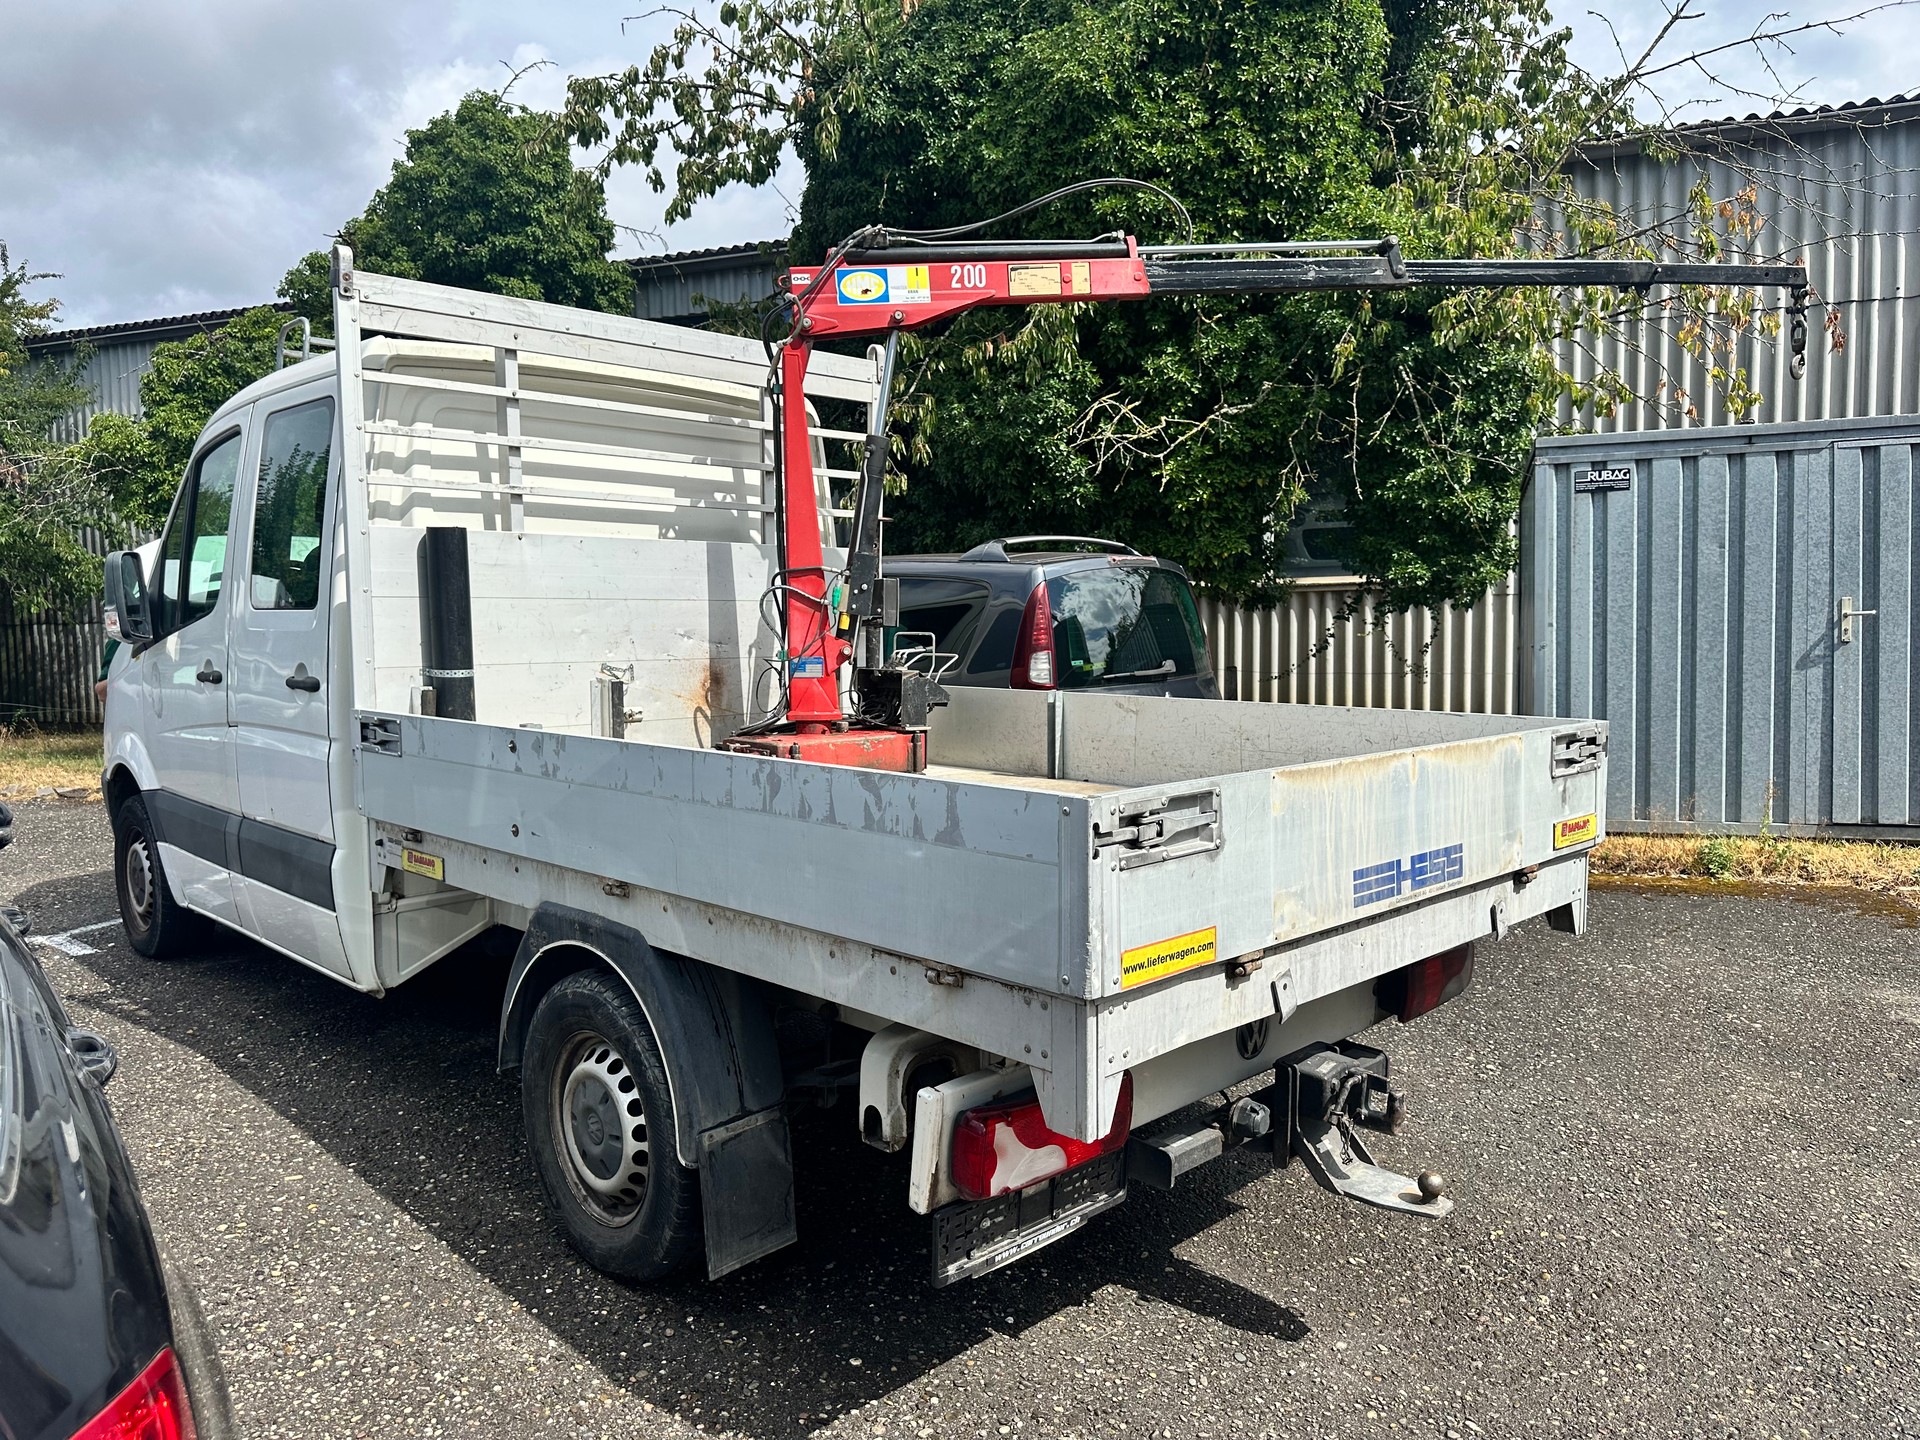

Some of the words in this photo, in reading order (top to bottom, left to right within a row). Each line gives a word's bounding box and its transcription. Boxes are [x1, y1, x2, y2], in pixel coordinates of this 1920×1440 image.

[950, 264, 986, 288] 200
[1587, 469, 1629, 481] RUBAG
[1122, 941, 1214, 975] www.lieferwagen.com
